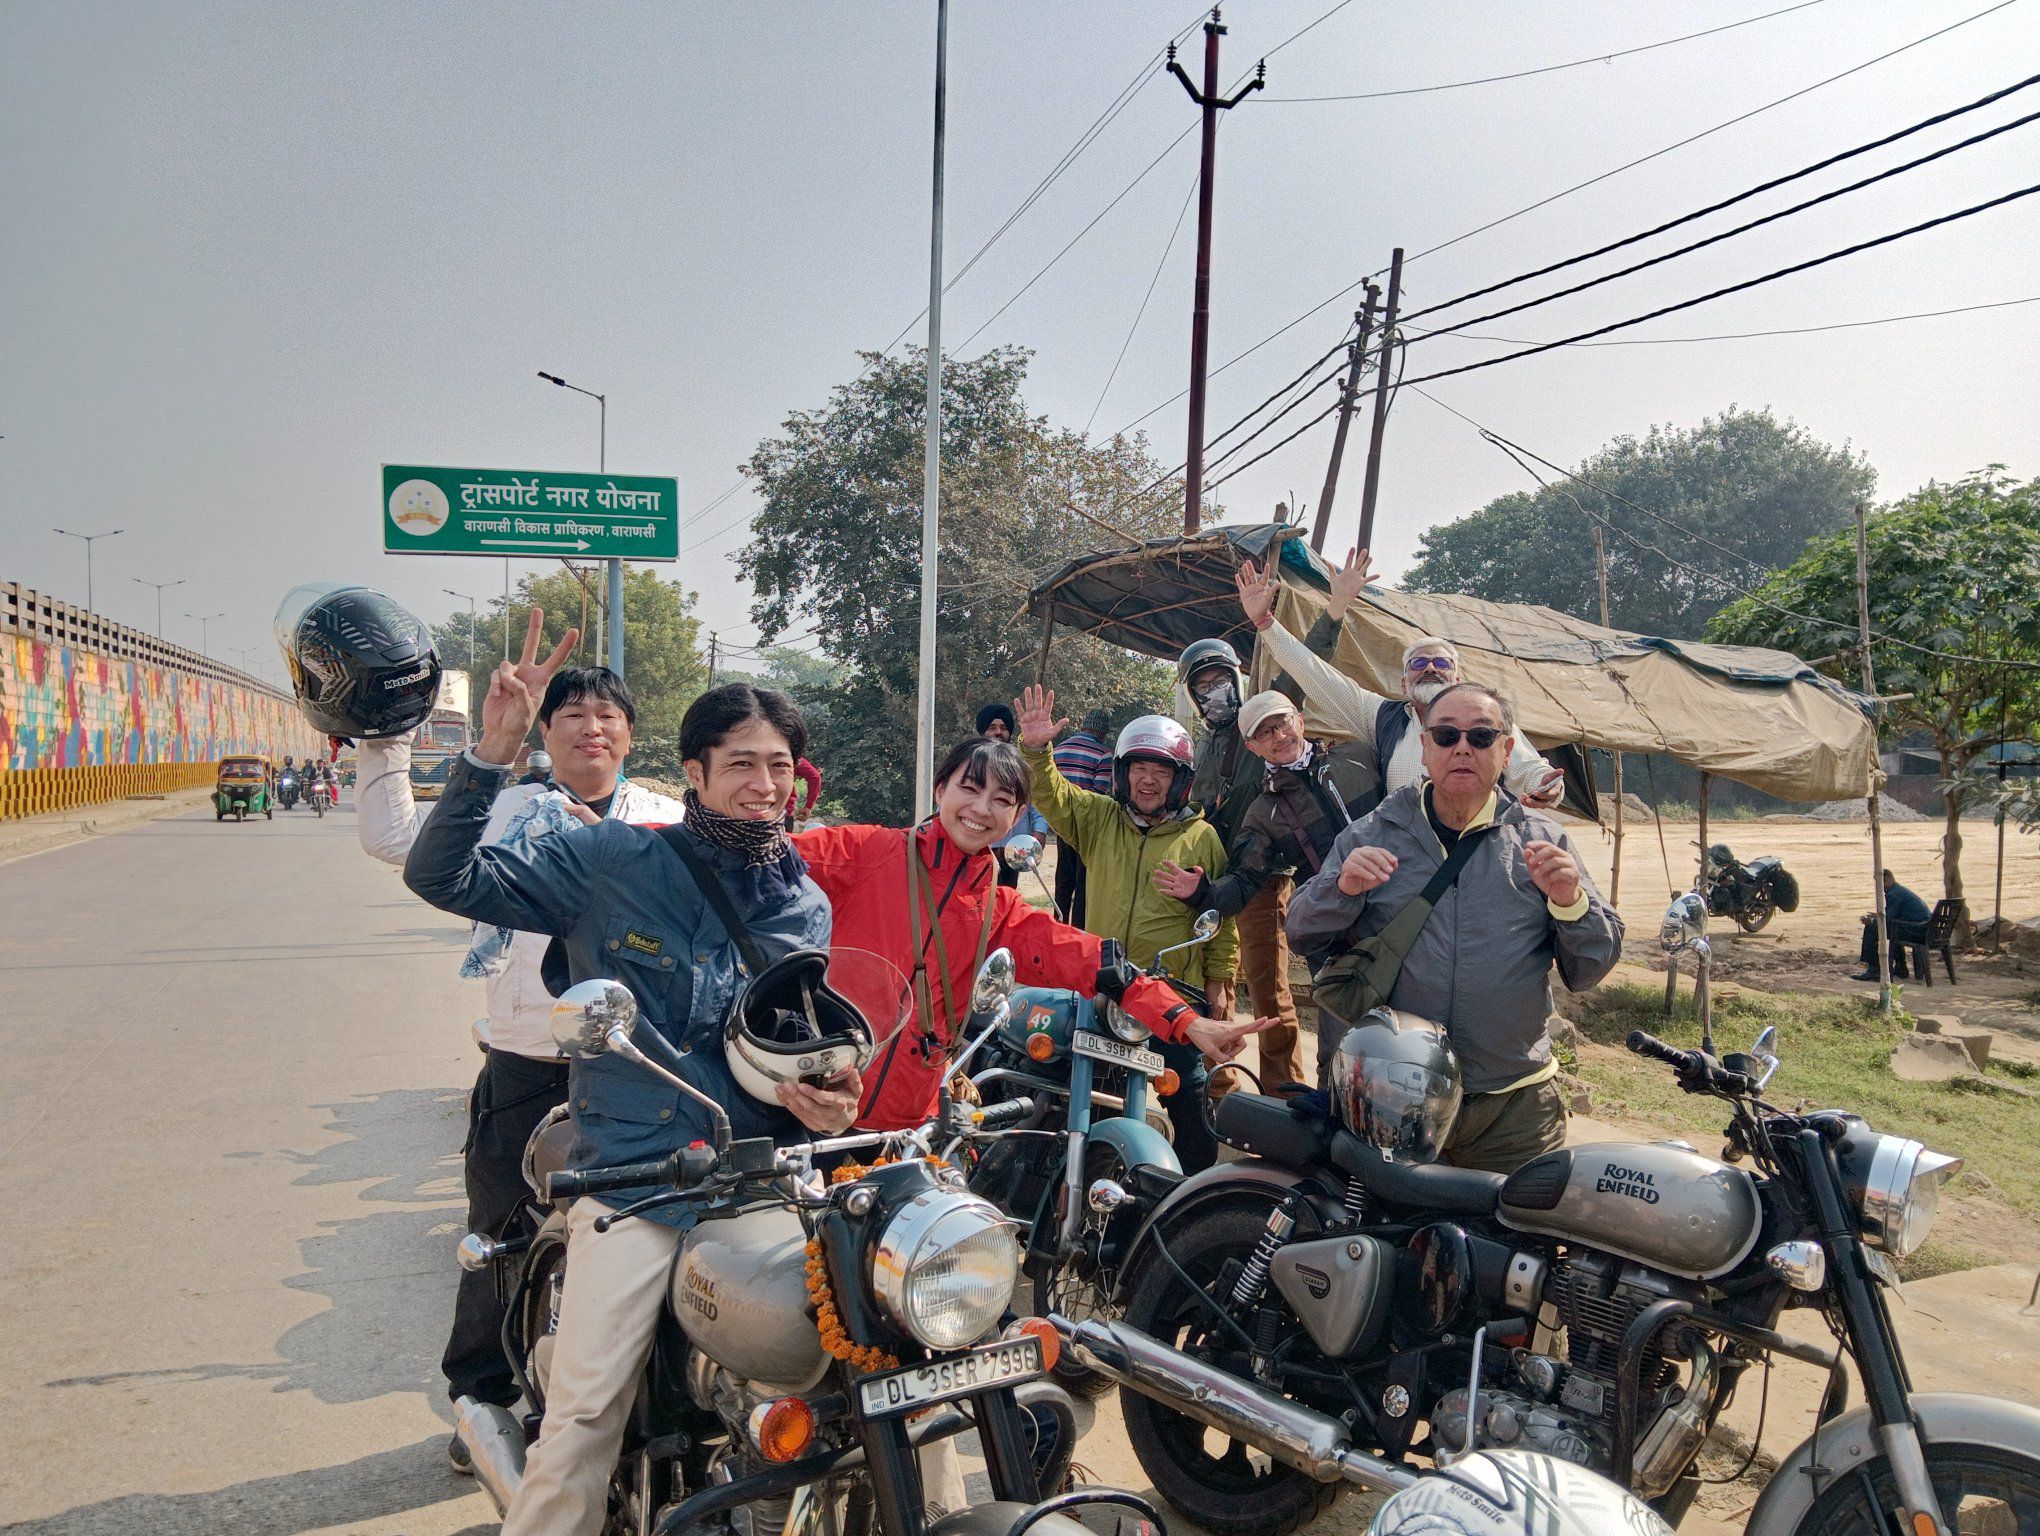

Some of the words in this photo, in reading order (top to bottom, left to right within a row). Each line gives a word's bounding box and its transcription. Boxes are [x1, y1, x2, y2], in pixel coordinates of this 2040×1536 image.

[460, 477, 539, 509] ट्रांसपोर्ट
[545, 486, 590, 508] नगर
[596, 481, 662, 511] योजना
[463, 517, 512, 534] वाराणसी
[514, 518, 551, 535] विकास
[611, 522, 656, 539] वाराणसी
[635, 937, 661, 950] Belstaff
[1030, 1012, 1052, 1031] 49
[1088, 1036, 1101, 1050] DL
[1106, 1042, 1132, 1059] 9SBY
[1603, 1163, 1655, 1187] ROYAL
[1596, 1178, 1660, 1205] ENFIELD
[685, 1265, 715, 1298] ROYAL
[680, 1285, 719, 1322] ENFIELD
[886, 1377, 916, 1405] DL
[926, 1357, 979, 1393] 3SER
[987, 1345, 1038, 1379] 7996
[871, 1400, 885, 1411] IND
